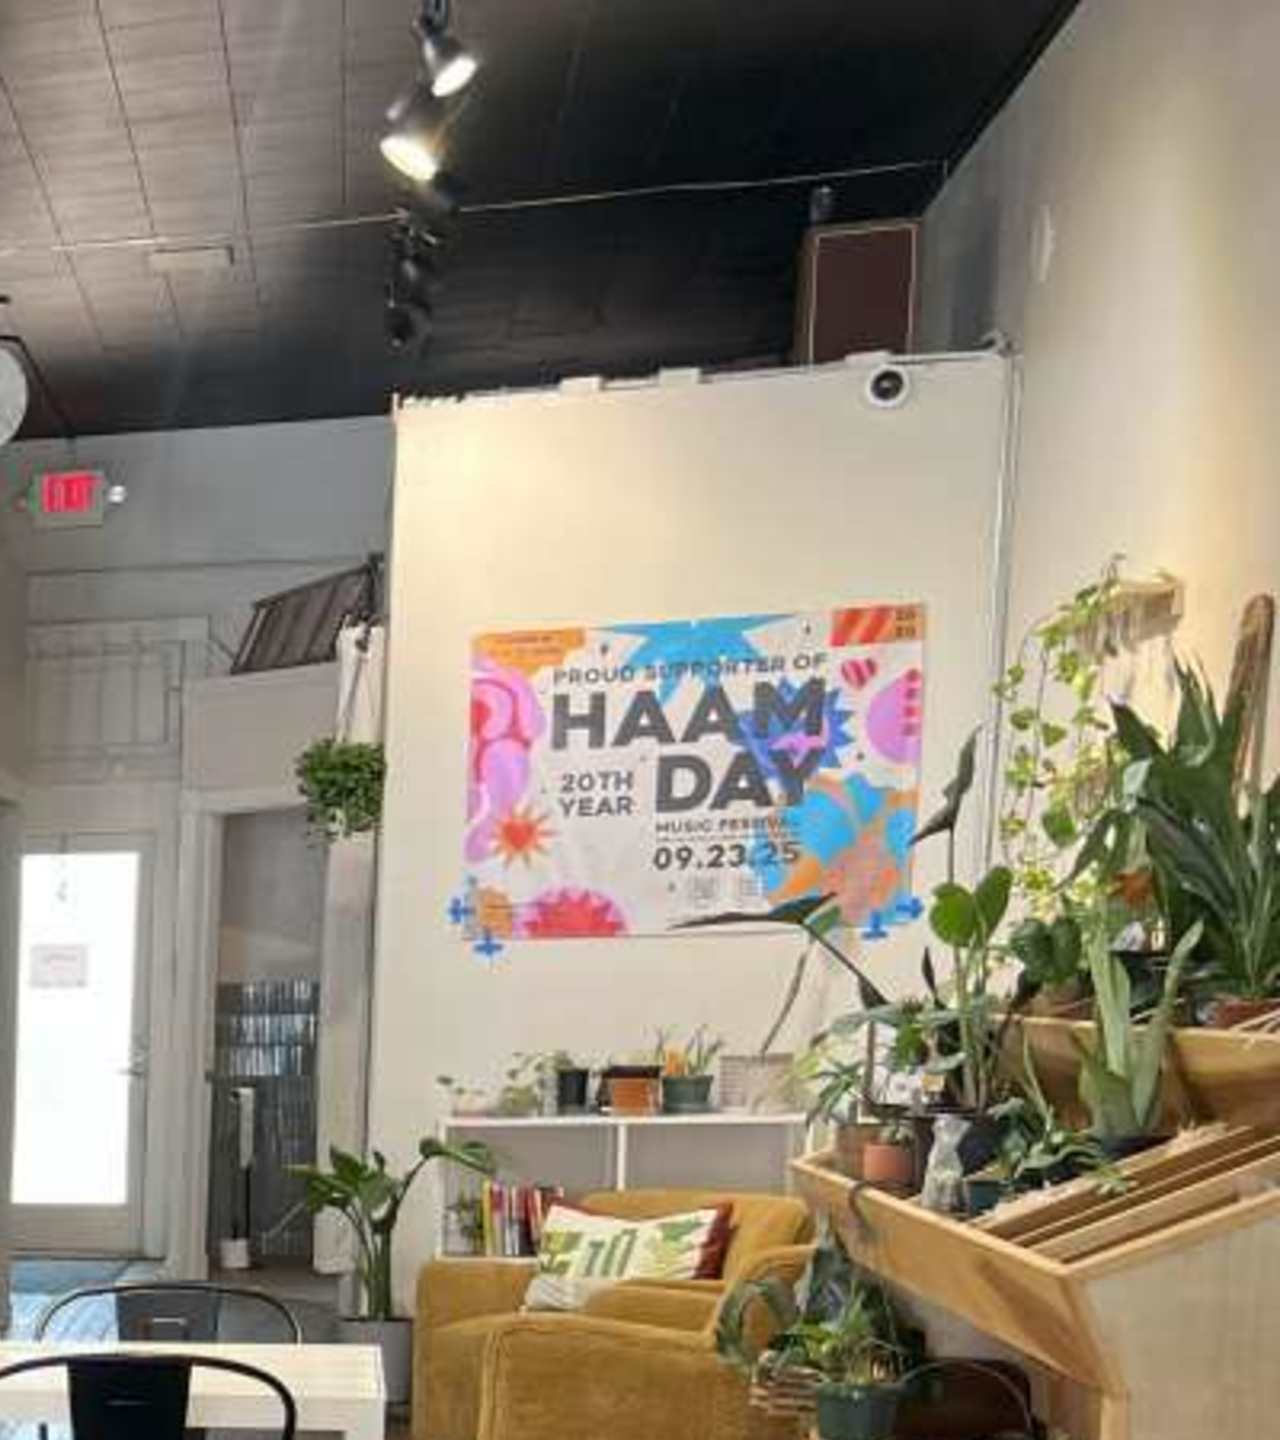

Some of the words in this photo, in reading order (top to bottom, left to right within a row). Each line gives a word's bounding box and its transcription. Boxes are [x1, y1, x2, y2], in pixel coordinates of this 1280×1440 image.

[553, 664, 635, 685] PROUD
[644, 656, 786, 680] SUPPORTER
[792, 652, 828, 670] OF
[551, 677, 827, 750] HAAM
[560, 770, 633, 793] 20TH
[655, 749, 828, 814] DAY
[559, 796, 633, 817] YEAR
[655, 817, 713, 834] MUSIC
[653, 841, 800, 871] 09.23.25
